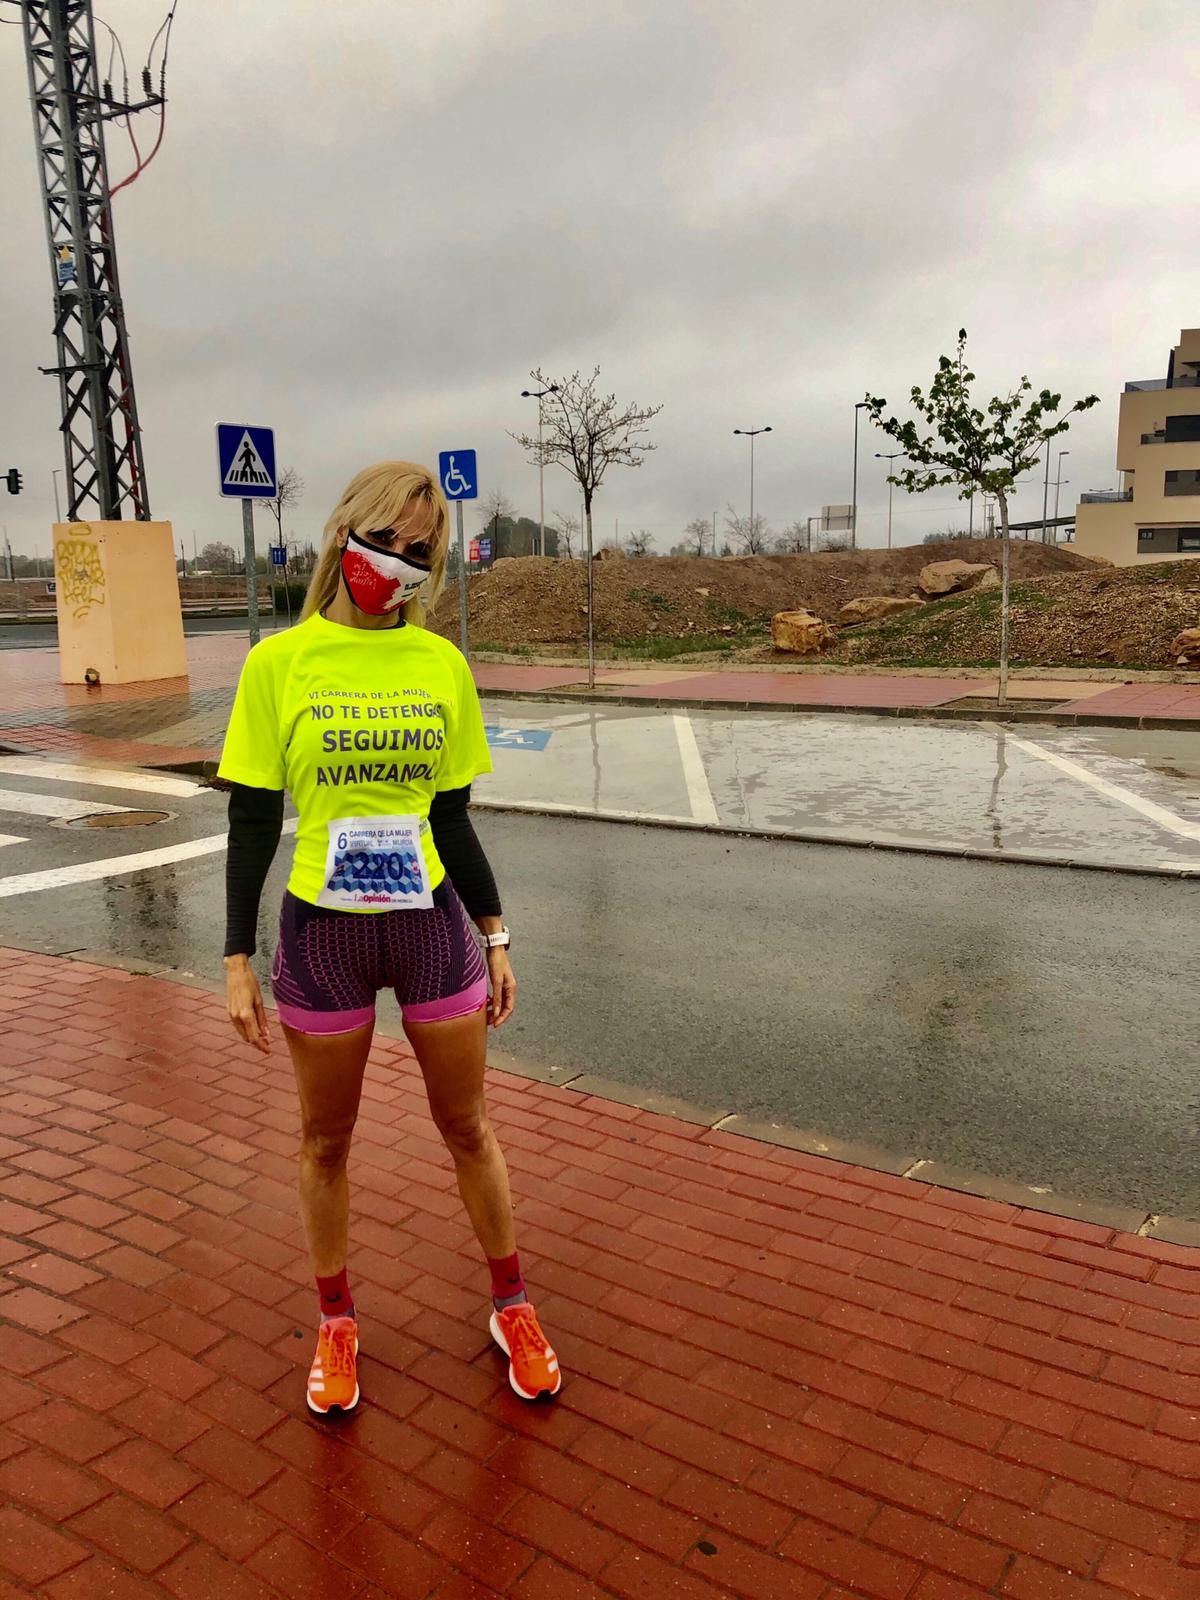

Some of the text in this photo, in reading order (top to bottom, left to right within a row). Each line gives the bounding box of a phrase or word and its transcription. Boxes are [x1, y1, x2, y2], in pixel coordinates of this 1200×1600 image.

[309, 691, 319, 700] VI
[321, 689, 368, 699] CARRERA
[311, 704, 334, 720] NO
[340, 705, 361, 719] TE
[322, 728, 443, 752] SEGUIMOS
[337, 832, 348, 849] 6
[349, 830, 377, 838] CARRERA
[386, 829, 395, 837] LA
[395, 829, 413, 837] MUJER
[352, 852, 404, 880] 220
